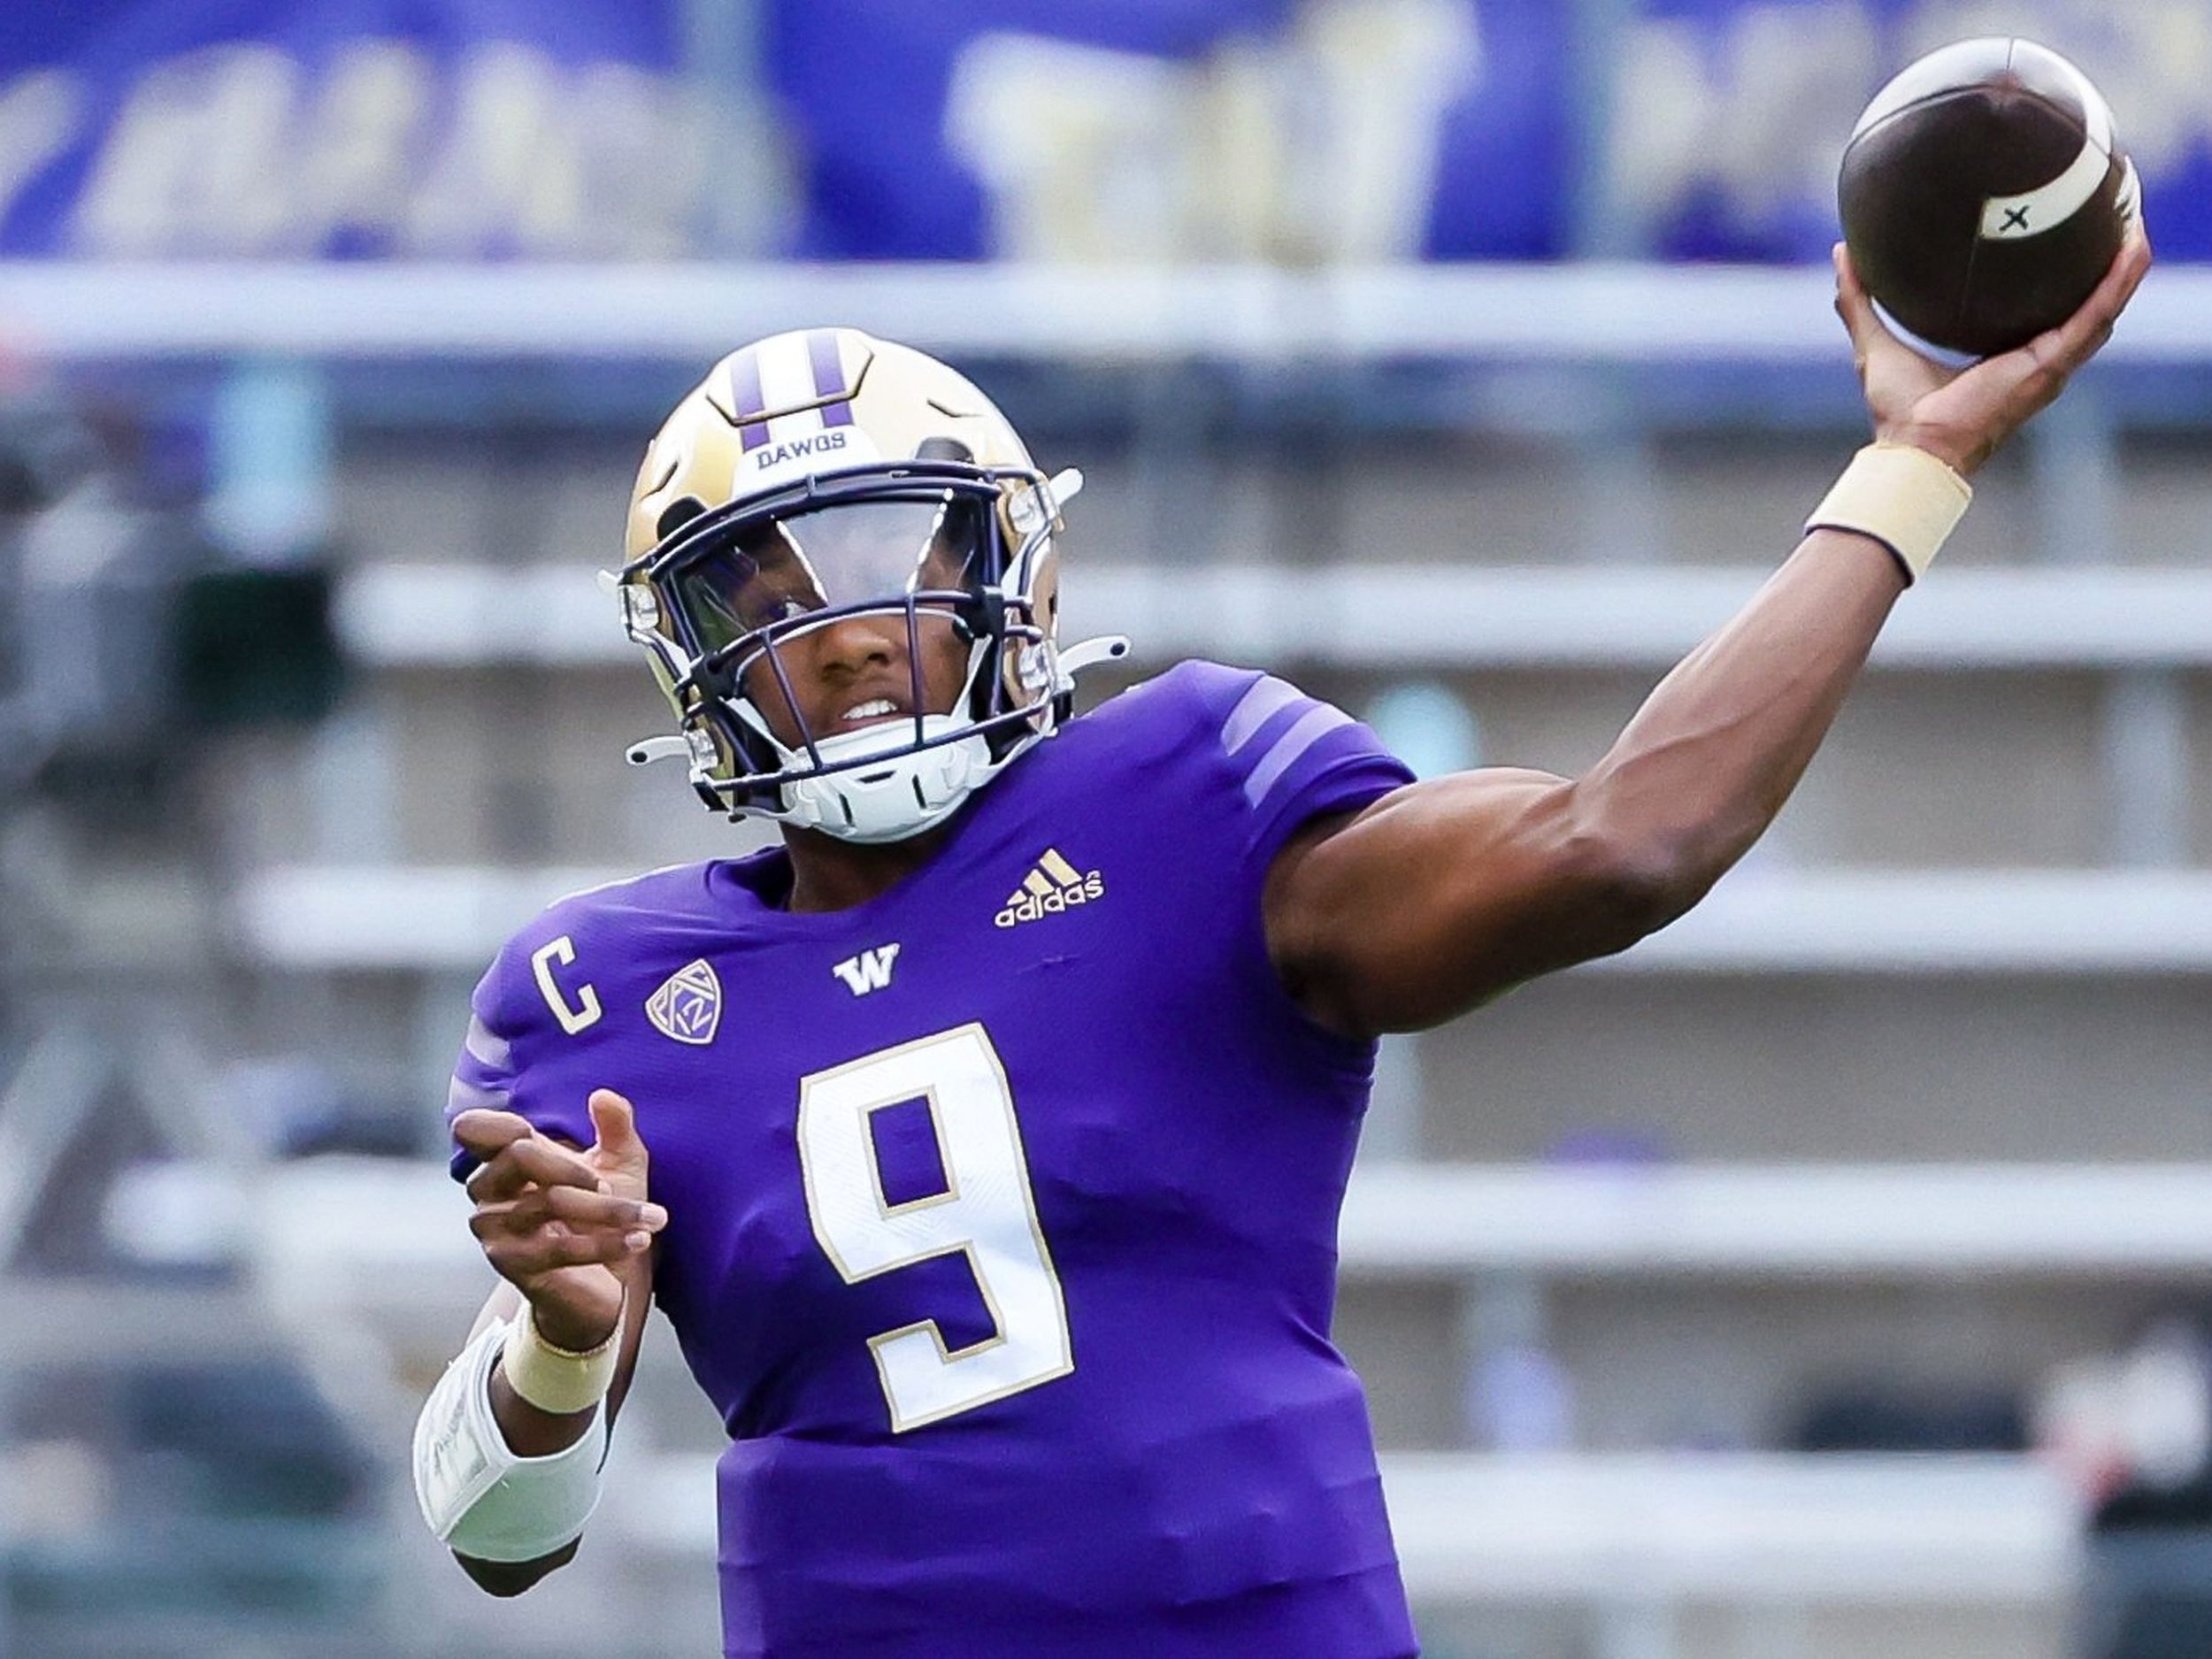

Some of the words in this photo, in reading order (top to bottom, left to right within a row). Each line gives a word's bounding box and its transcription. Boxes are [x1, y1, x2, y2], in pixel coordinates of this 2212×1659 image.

[757, 432, 847, 470] DAWGS
[995, 872, 1104, 927] adidas
[532, 935, 602, 1034] C
[833, 942, 901, 996] W
[797, 1022, 1074, 1433] 9
